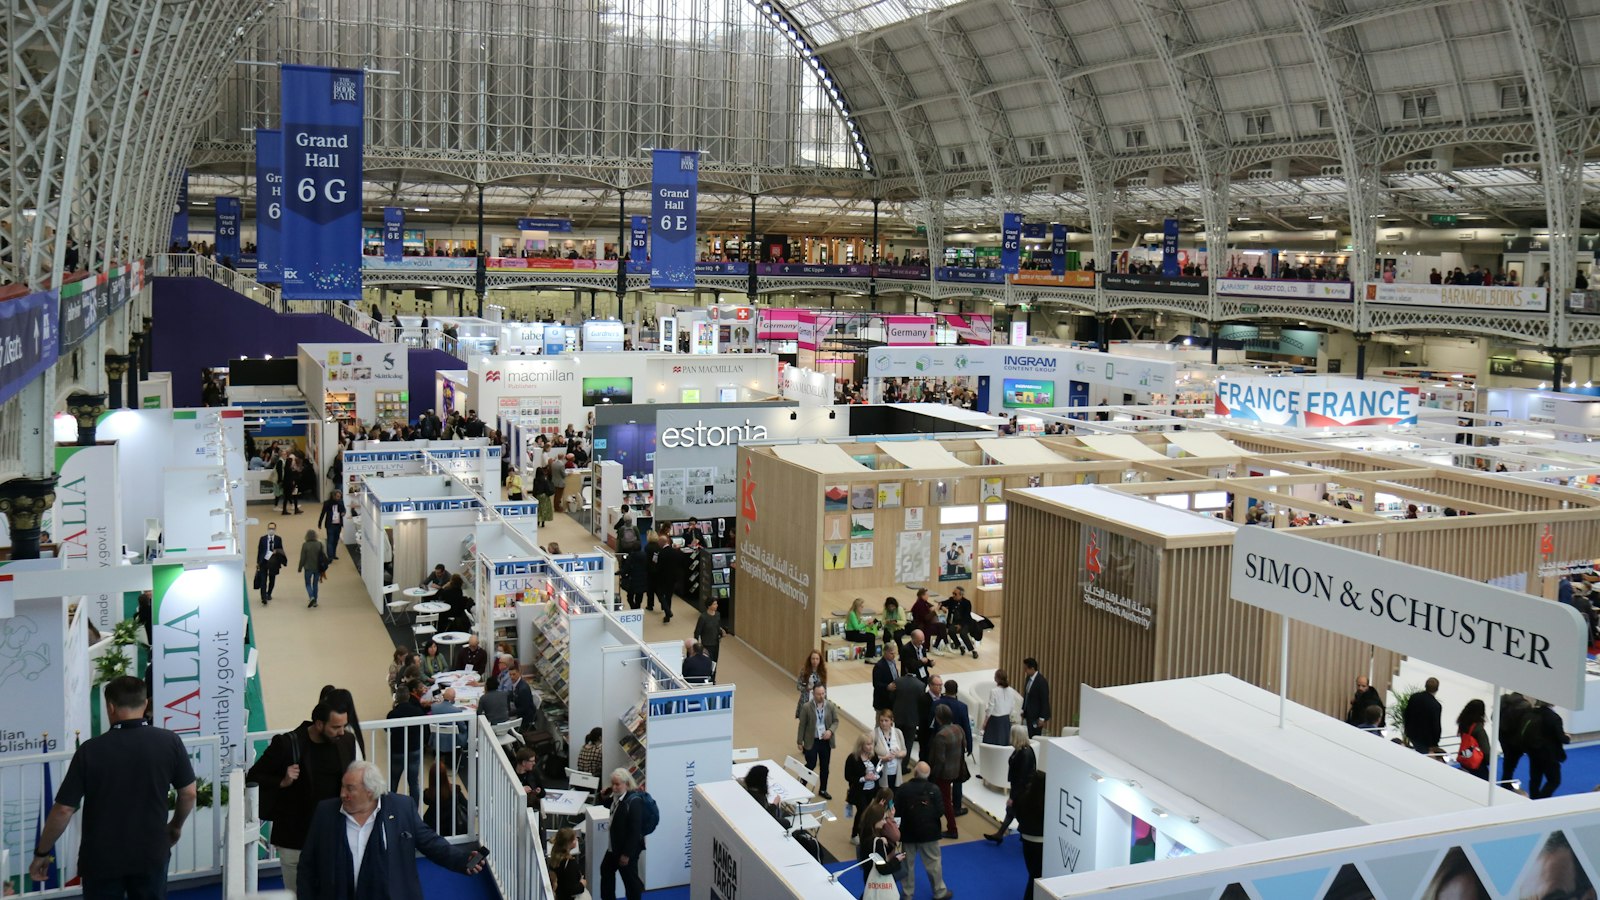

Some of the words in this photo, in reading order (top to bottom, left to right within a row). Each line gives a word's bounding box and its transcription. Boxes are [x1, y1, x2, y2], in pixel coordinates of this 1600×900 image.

[296, 132, 348, 149] Grand
[305, 153, 339, 168] Hall
[297, 177, 316, 203] 6
[324, 178, 347, 203] G
[660, 188, 689, 198] Grand
[268, 202, 281, 219] 6
[664, 200, 684, 210] Hall
[660, 215, 671, 231] 6
[676, 216, 687, 231] E
[220, 227, 226, 235] 6
[227, 227, 235, 235] G
[387, 232, 393, 240] 6
[394, 232, 400, 240] E
[633, 239, 639, 247] 6
[639, 239, 645, 247] D
[1005, 241, 1011, 249] 6
[1011, 241, 1018, 250] C
[1529, 241, 1542, 249] Lift
[1165, 246, 1170, 254] 6
[891, 327, 928, 338] Germany
[1004, 355, 1057, 368] INGRAM
[508, 369, 575, 382] macmillan
[682, 365, 698, 374] PAN
[699, 365, 744, 374] MACMILLAN
[1004, 365, 1034, 373] CONTENT
[1510, 365, 1523, 373] Lift
[1218, 381, 1300, 415] FRANCE
[1307, 390, 1411, 417] FRANCE
[661, 418, 768, 448] estonia
[499, 578, 534, 591] PGUK
[740, 555, 762, 580] Sharjah
[761, 567, 778, 589] Book
[777, 577, 809, 610] Authority
[1084, 593, 1106, 610] Sharjah
[1105, 601, 1121, 617] Book
[1120, 608, 1151, 631] Authority
[1245, 552, 1334, 602] SIMON
[1339, 580, 1364, 612] &
[1369, 587, 1553, 670] SCHUSTER
[620, 614, 642, 624] 6E30
[685, 760, 695, 778] UK
[685, 780, 697, 814] Group
[713, 836, 737, 886] MANGA
[713, 860, 737, 900] TAROT
[867, 882, 893, 890] BOOKBAR
